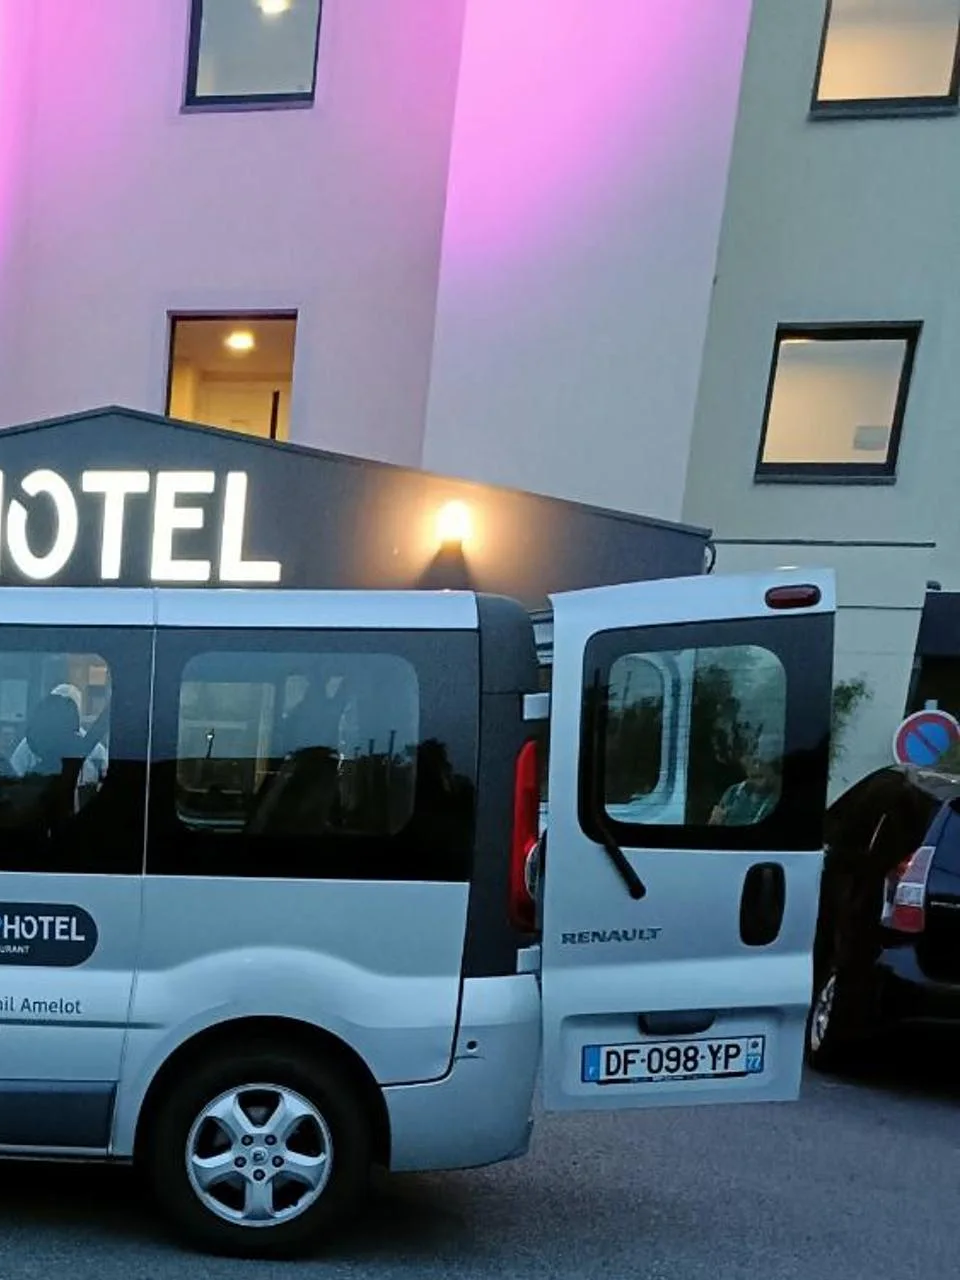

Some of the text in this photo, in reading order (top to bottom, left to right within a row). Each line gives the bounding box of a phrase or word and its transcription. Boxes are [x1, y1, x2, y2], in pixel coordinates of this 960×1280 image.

[561, 928, 662, 945] RENAULT
[21, 998, 82, 1014] Amelot
[605, 1044, 741, 1076] DF-098-YP
